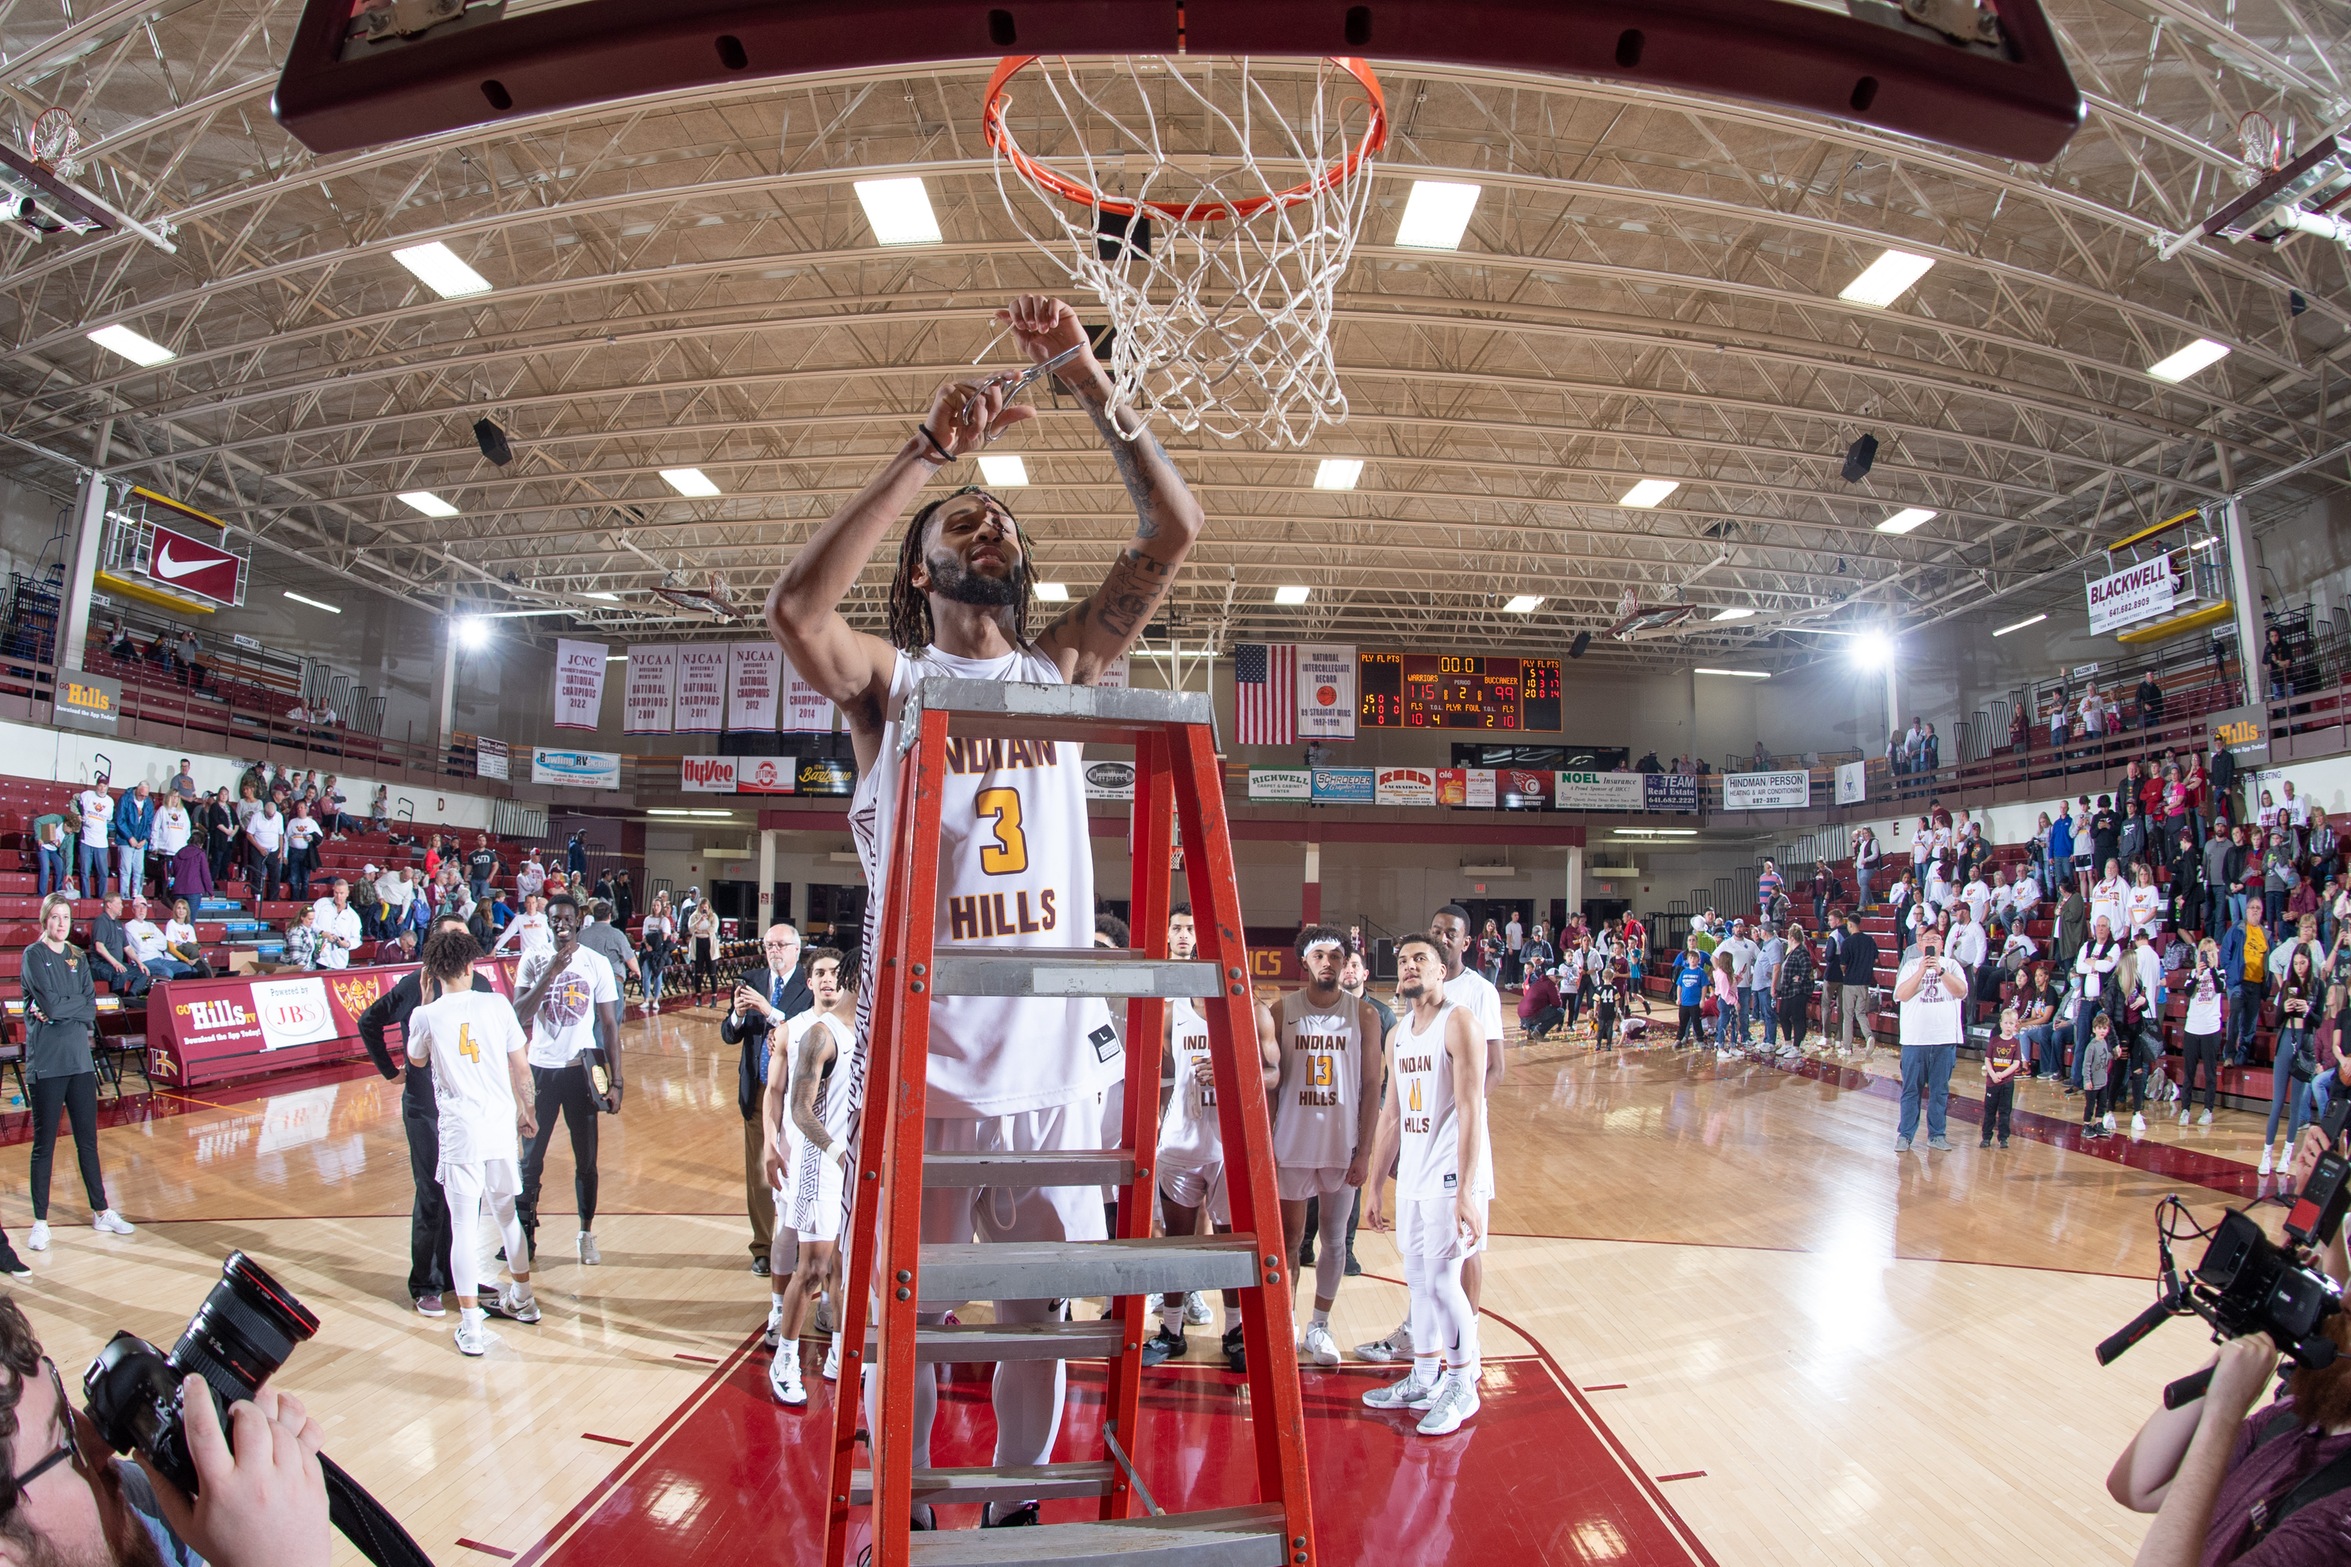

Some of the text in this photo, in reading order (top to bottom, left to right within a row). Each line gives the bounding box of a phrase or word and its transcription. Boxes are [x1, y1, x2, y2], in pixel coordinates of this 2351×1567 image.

[2090, 562, 2165, 605] BLACKWELL
[2120, 581, 2167, 601] COMPANY
[2109, 597, 2150, 618] 641.682.8909
[2214, 626, 2235, 637] BALCONY
[235, 635, 253, 647] BALCONY
[568, 654, 597, 667] JCNC
[632, 654, 671, 666] NJCAA
[682, 653, 722, 665] NJCAA
[737, 651, 775, 662] NJCAA
[1312, 653, 1339, 662] NATIONAL
[1361, 654, 1400, 663] PLY FL PTS
[1302, 664, 1350, 673] INTERCOLLEGIATE
[1441, 657, 1474, 673] 00.0
[1537, 660, 1545, 668] FL
[1530, 669, 1559, 678] 5 4 7
[2075, 666, 2092, 676] BALCONY
[566, 674, 595, 687] NATIONAL
[740, 676, 768, 687] NATIONAL
[1315, 674, 1337, 684] RECORD
[1407, 674, 1518, 685] WARRIORS BUCCANEER
[1527, 679, 1559, 688] 10 3 17
[562, 686, 597, 699] CHAMPIONS
[632, 684, 666, 694] NATIONAL
[683, 683, 717, 693] NATIONAL
[737, 688, 770, 699] CHAMPIONS
[1411, 684, 1514, 700] 115 2 99
[1525, 688, 1560, 698] 20 0 14
[59, 681, 118, 711] GO Hills TV
[680, 696, 720, 706] CHAMPIONS
[789, 695, 828, 706] CHAMPIONS
[1365, 694, 1400, 704] 15 0 4
[628, 698, 669, 708] CHAMPIONS
[745, 700, 760, 710] 2012
[1362, 704, 1400, 714] 21 0 0
[1410, 702, 1423, 711] FLS
[1445, 703, 1462, 712] PLYR
[1465, 704, 1481, 712] FOUL
[1502, 705, 1515, 713] FLS
[56, 704, 117, 722] Download the App Today!
[690, 708, 707, 718] 2011
[799, 708, 816, 719] 2014
[1310, 708, 1351, 717] STRAIGHT WINS
[1313, 718, 1340, 727] 1997-1999
[1378, 715, 1384, 725] 0
[1411, 713, 1515, 728] 10 4 2 10
[2218, 720, 2266, 745] Hills TV
[2241, 746, 2251, 754] App
[2251, 742, 2267, 751] Today!
[540, 752, 613, 769] Bowling RVs.com
[944, 737, 1058, 775] NDIAN
[684, 759, 733, 787] HyVee
[755, 770, 778, 780] OTTUMWA
[1318, 774, 1371, 784] SCHROEDER
[1379, 769, 1432, 787] REED
[1439, 770, 1453, 779] olé
[1562, 772, 1637, 785] NOEL Insurance
[2257, 771, 2282, 782] SEATING
[1252, 774, 1309, 785] RICHWELL
[1662, 776, 1695, 788] TEAM
[1648, 787, 1695, 796] Real Estate
[1729, 789, 1751, 797] HEATING
[1767, 787, 1803, 795] CONDITIONING
[438, 798, 445, 812] D
[974, 786, 1029, 877] 3
[1893, 822, 1900, 836] E
[949, 888, 1056, 940] HILLS
[270, 987, 309, 997] Powered by
[1601, 989, 1614, 1003] 44
[176, 999, 256, 1031] GO Hills TV
[277, 1002, 317, 1026] JBS
[183, 1028, 262, 1045] Download the App Today!
[1098, 1032, 1108, 1041] L
[459, 1022, 481, 1064] 4
[1183, 1035, 1210, 1051] IND
[1295, 1035, 1347, 1051] INDIAN
[1399, 1055, 1432, 1074] INDAN
[1306, 1055, 1334, 1087] 13
[1298, 1091, 1337, 1106] HILLS
[1409, 1078, 1422, 1112] 11
[1404, 1117, 1430, 1134] HLLS
